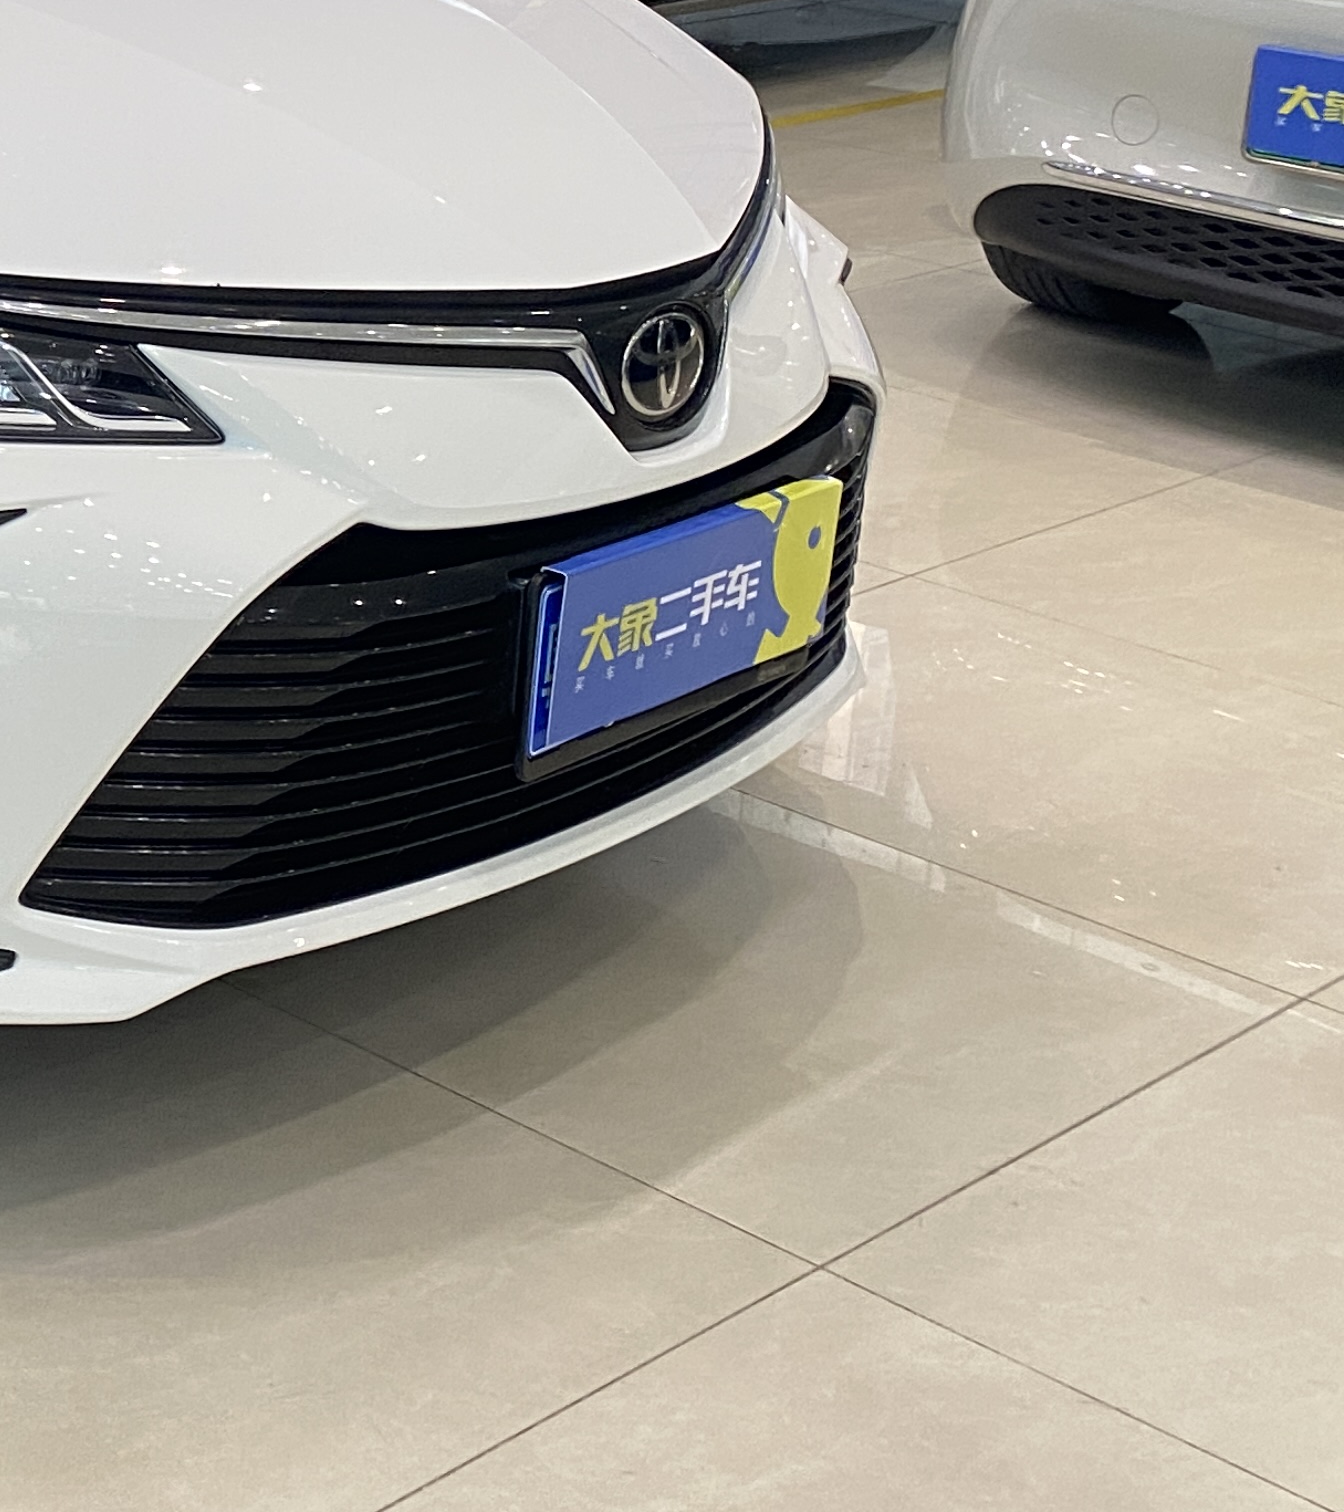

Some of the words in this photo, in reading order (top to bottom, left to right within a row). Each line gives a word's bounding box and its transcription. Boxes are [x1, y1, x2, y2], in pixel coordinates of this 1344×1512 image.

[577, 560, 762, 672] 大象二手车
